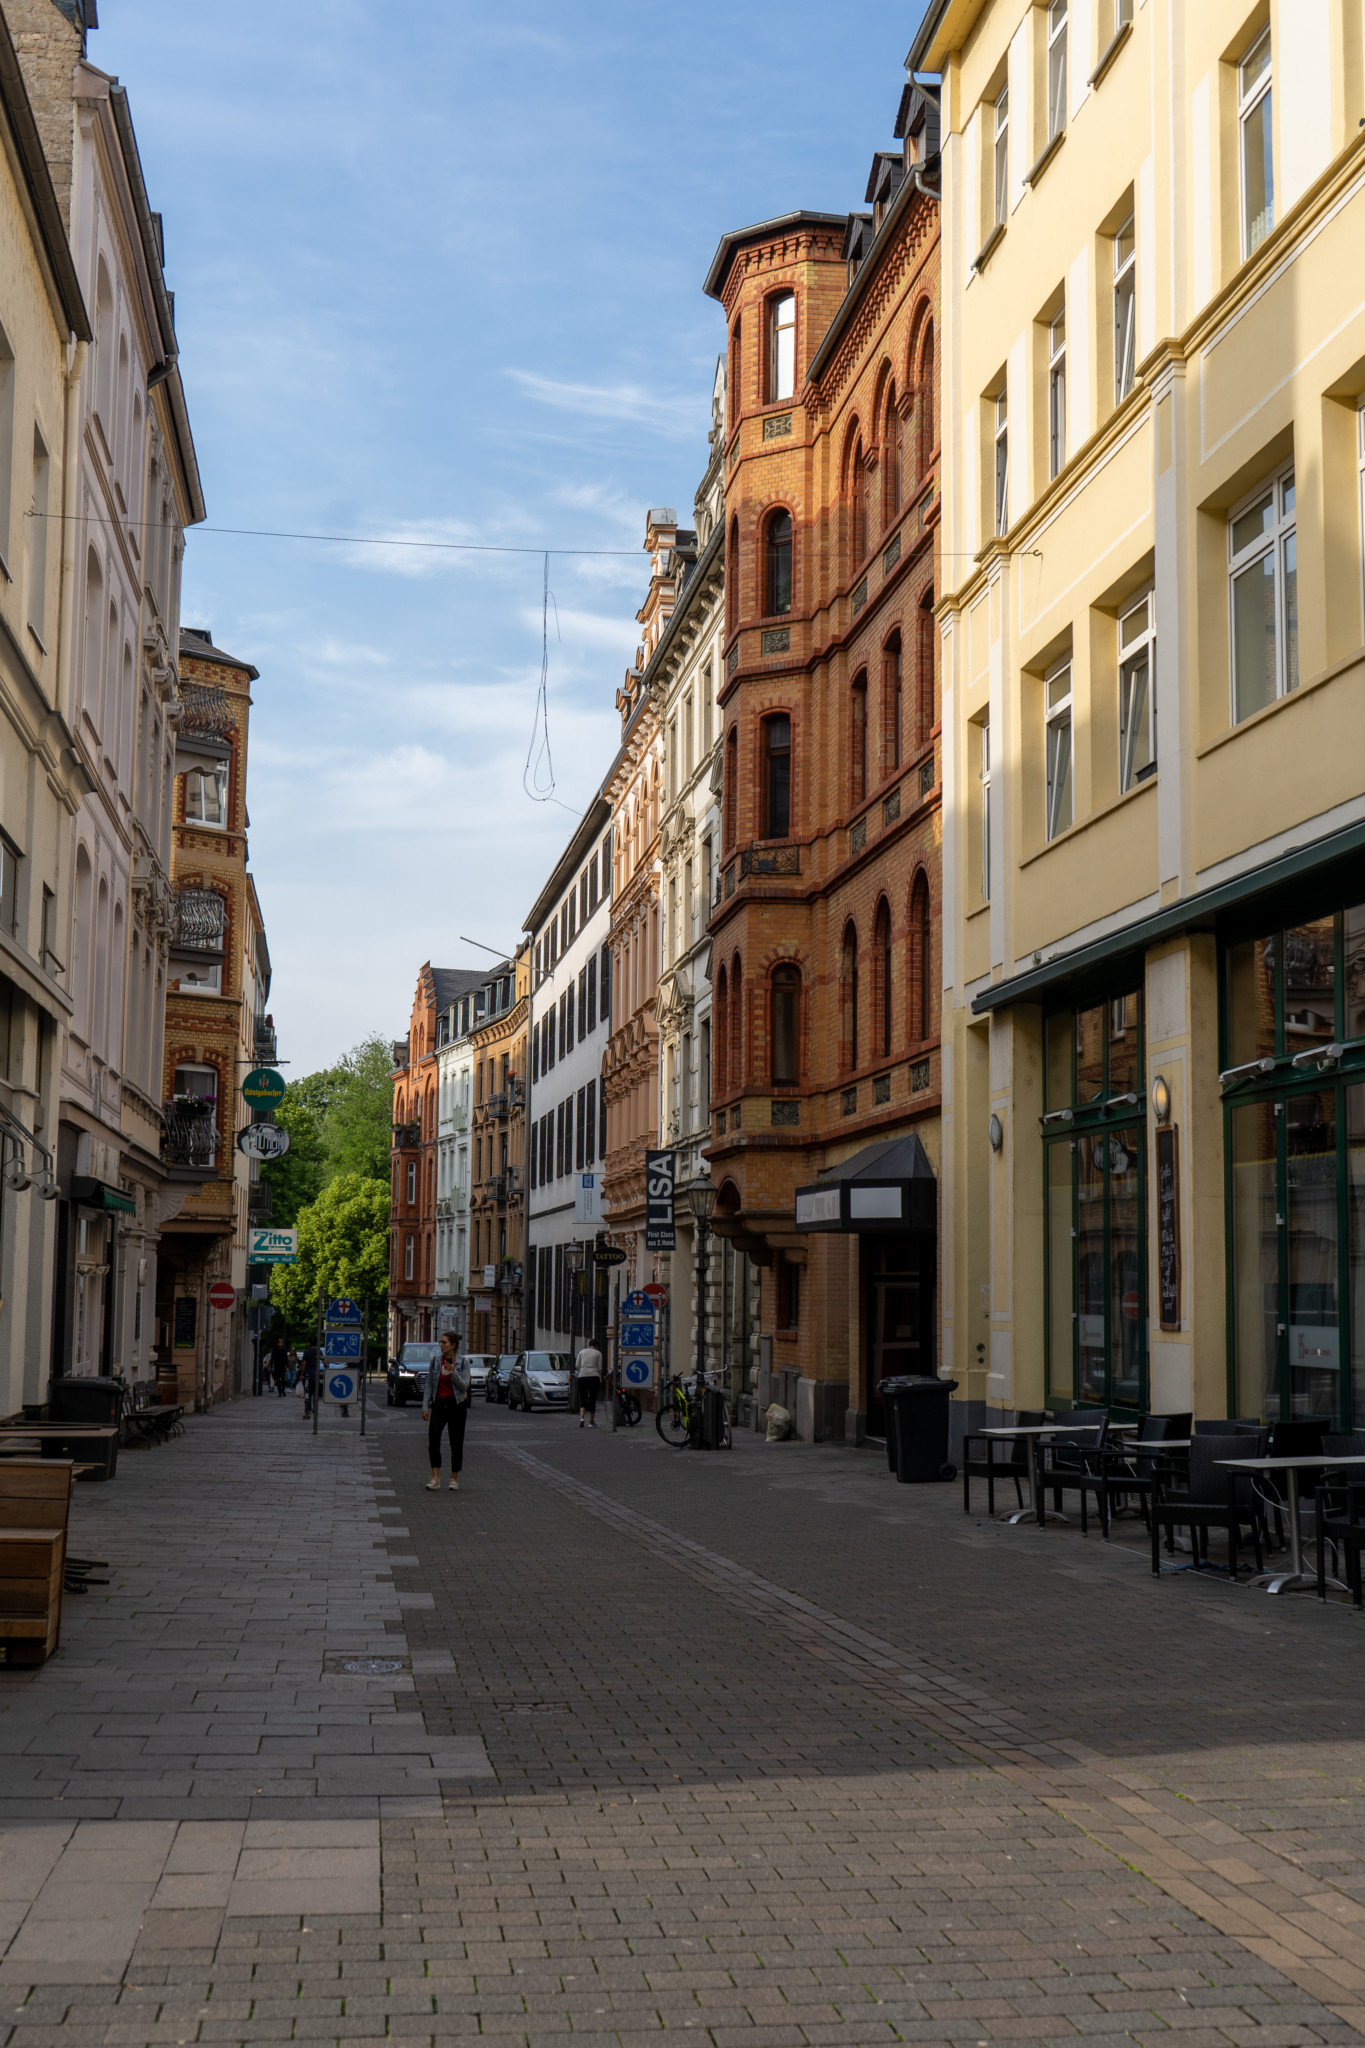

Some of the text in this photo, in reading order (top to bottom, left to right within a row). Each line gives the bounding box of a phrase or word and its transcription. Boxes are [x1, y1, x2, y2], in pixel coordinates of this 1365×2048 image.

[244, 1088, 282, 1097] Königsbacher
[648, 1154, 672, 1225] LISA
[254, 1231, 292, 1251] Zitto
